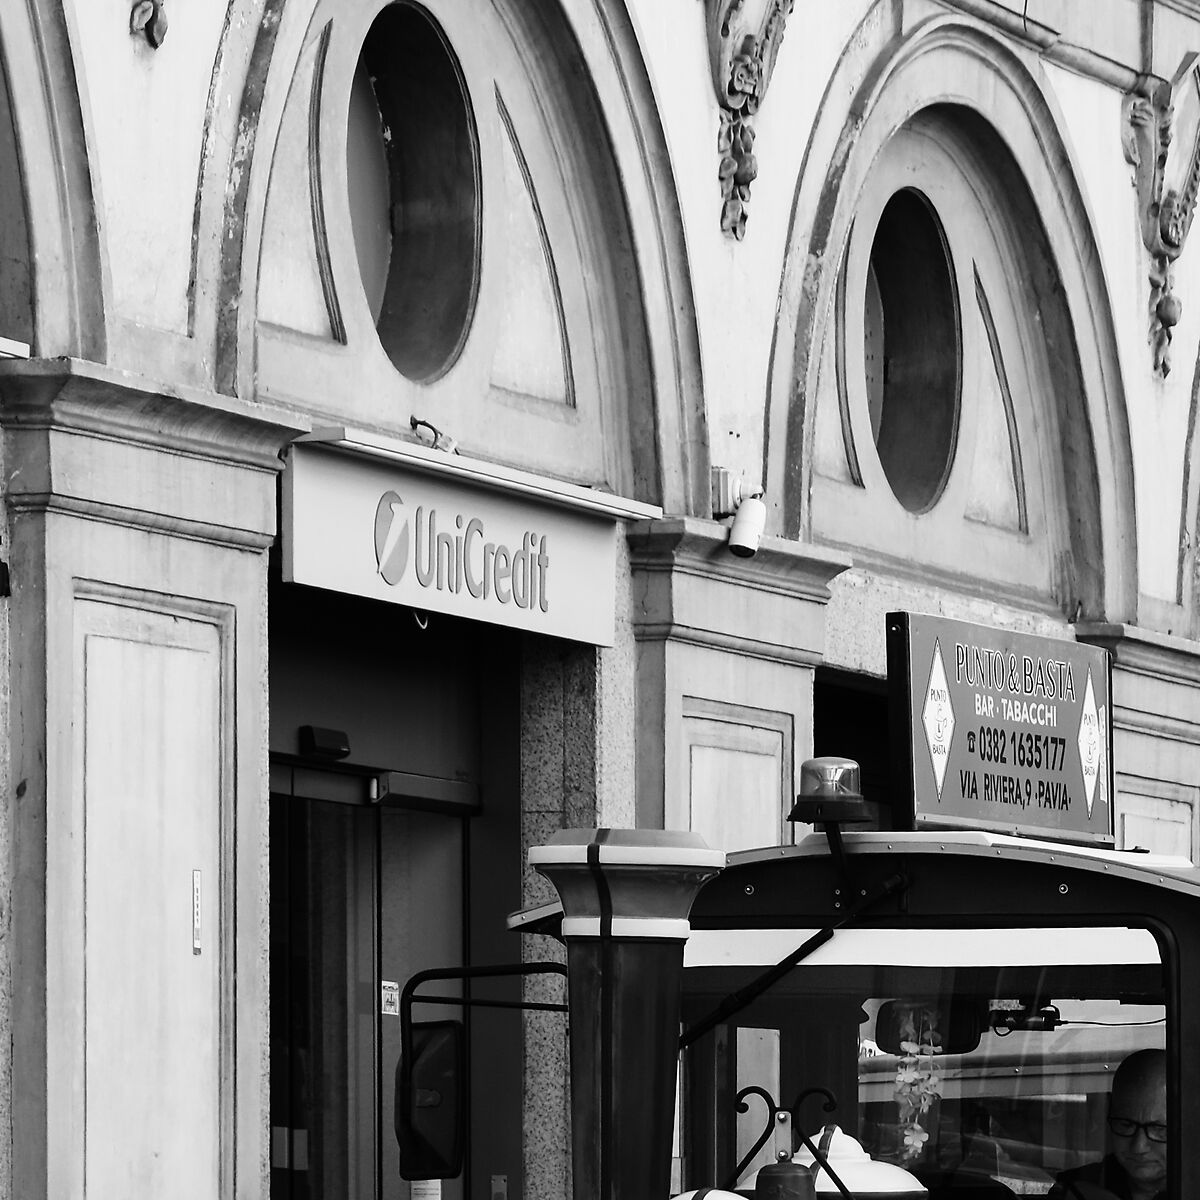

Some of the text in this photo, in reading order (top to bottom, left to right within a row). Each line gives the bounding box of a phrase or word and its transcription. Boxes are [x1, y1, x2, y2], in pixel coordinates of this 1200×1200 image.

[415, 505, 549, 613] UniCredit
[955, 642, 1076, 702] PUNTO & BASTA
[930, 688, 947, 703] PUNTO
[975, 694, 1057, 727] BAR TABACCHI
[932, 743, 946, 756] BASTA
[979, 726, 1066, 772] 0382 1635177
[960, 769, 978, 800] VIA
